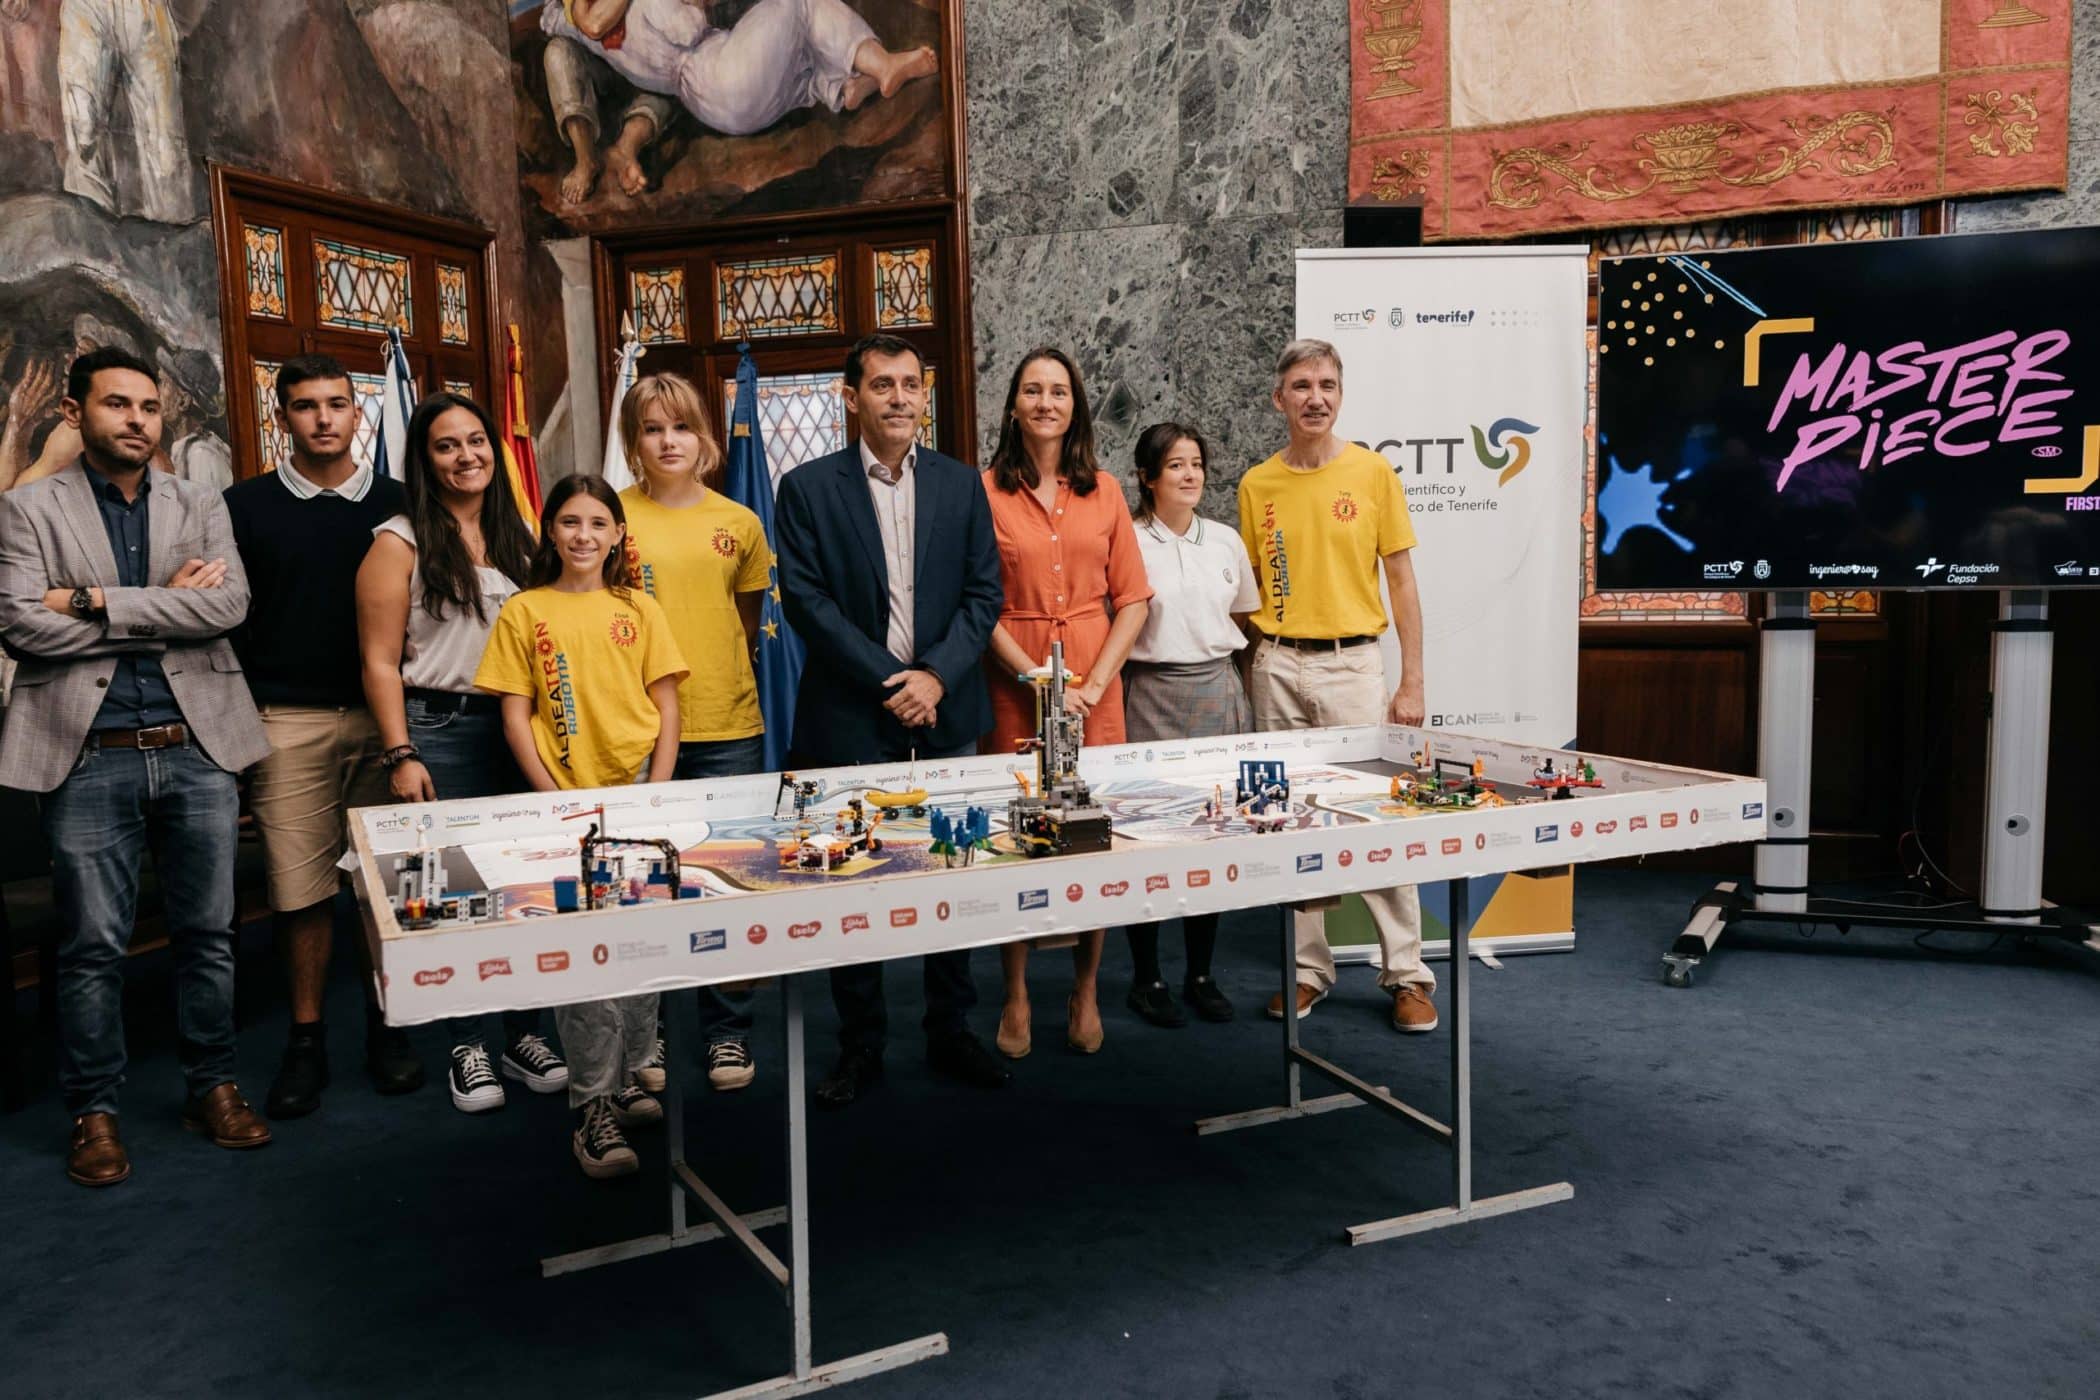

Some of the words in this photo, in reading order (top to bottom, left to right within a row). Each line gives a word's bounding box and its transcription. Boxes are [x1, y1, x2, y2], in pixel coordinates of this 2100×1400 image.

[1334, 312, 1360, 322] PCTT
[1767, 329, 2071, 432] MASTER
[1352, 438, 1464, 474] CTT
[1458, 485, 1466, 497] y
[1428, 501, 1444, 512] de
[1447, 499, 1498, 512] Tenerife
[2065, 496, 2100, 511] FIRST
[1704, 564, 1729, 572] PCTT
[1949, 563, 2000, 573] Fundación
[1946, 574, 1978, 585] Cepsa
[556, 652, 578, 735] ROBOTIX
